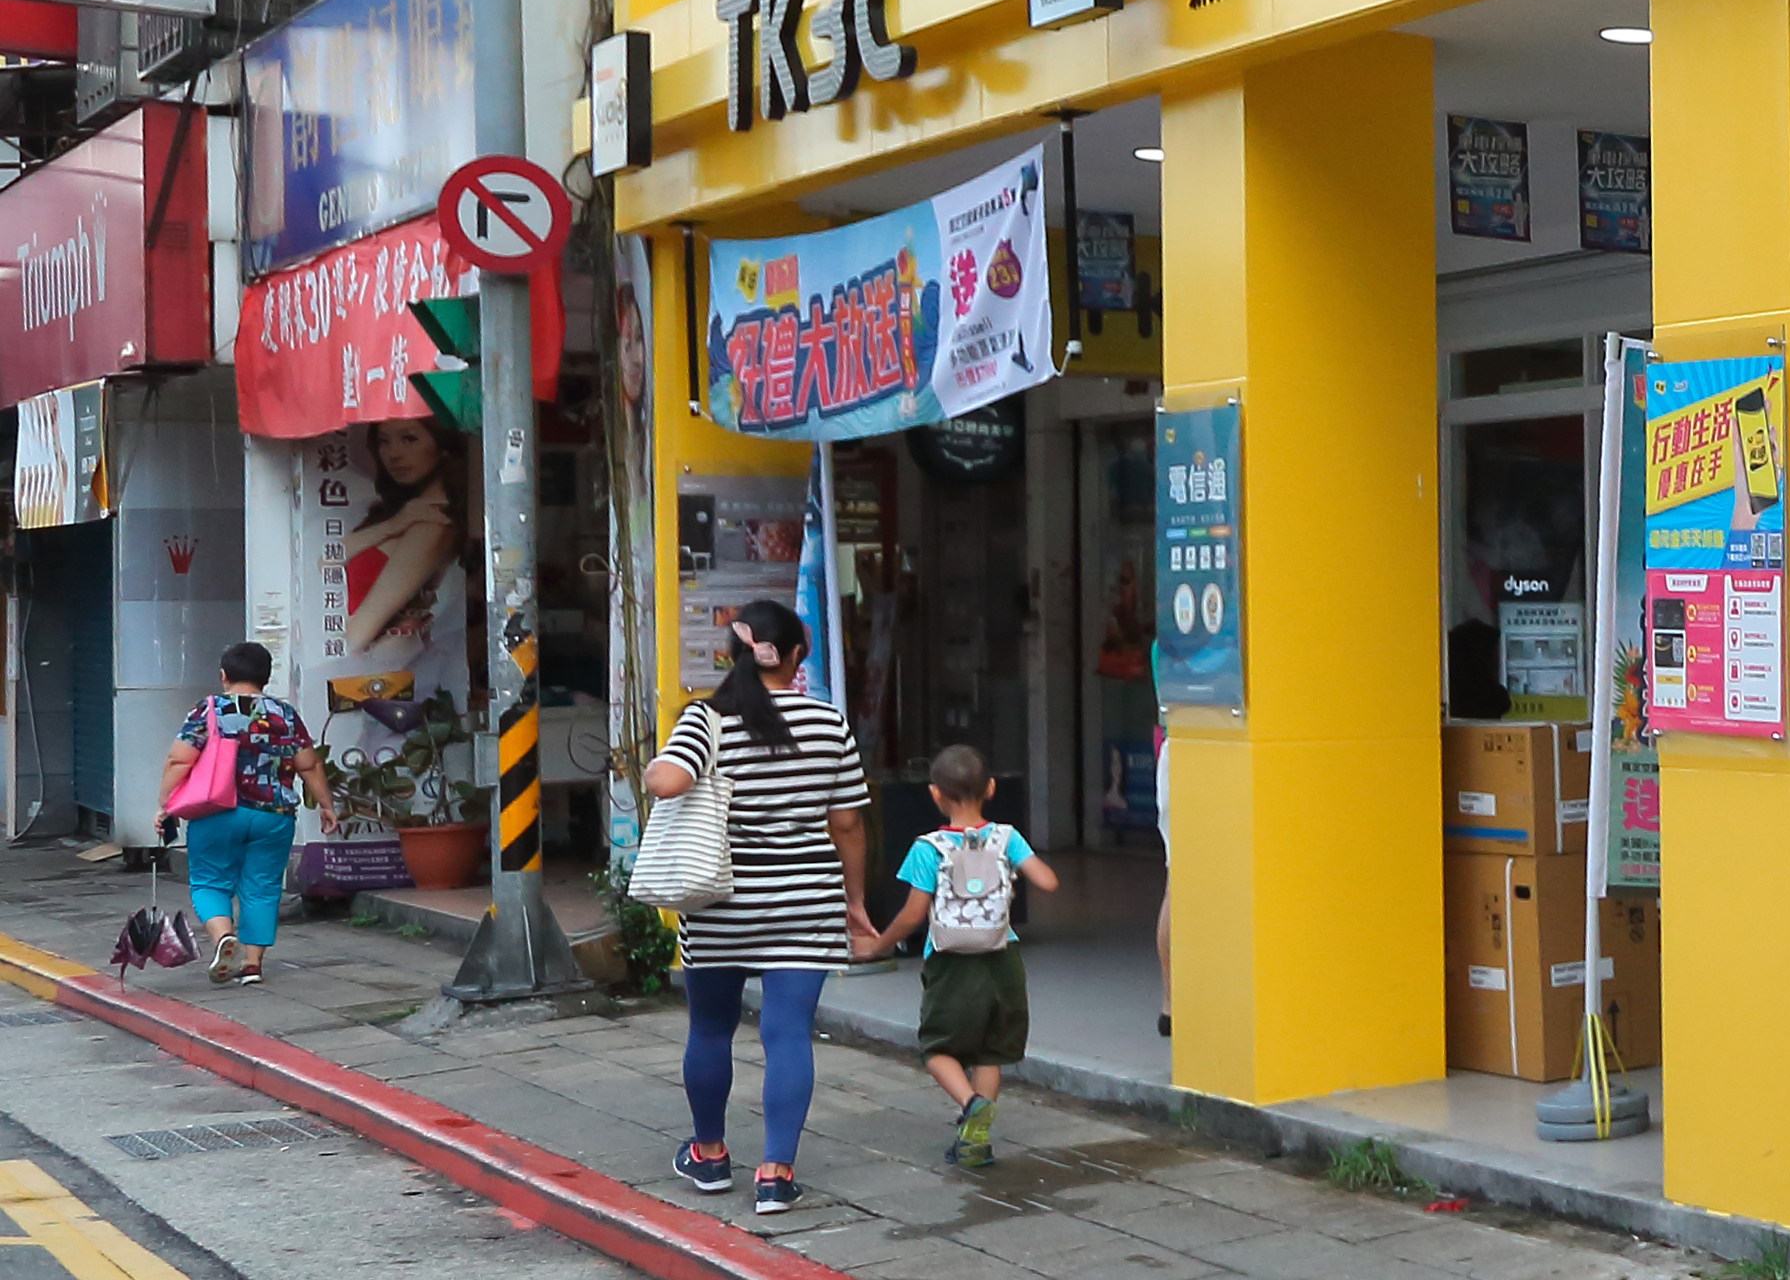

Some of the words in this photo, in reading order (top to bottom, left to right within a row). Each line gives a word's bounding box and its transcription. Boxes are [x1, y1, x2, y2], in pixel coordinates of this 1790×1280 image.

[1458, 151, 1521, 176] 大攻略
[1587, 166, 1647, 190] 大攻略
[17, 215, 92, 342] Triumph
[726, 268, 901, 424] 好禮大放送
[1652, 396, 1735, 466] 行動生活
[317, 444, 350, 508] 彩色
[1503, 575, 1550, 597] dyson
